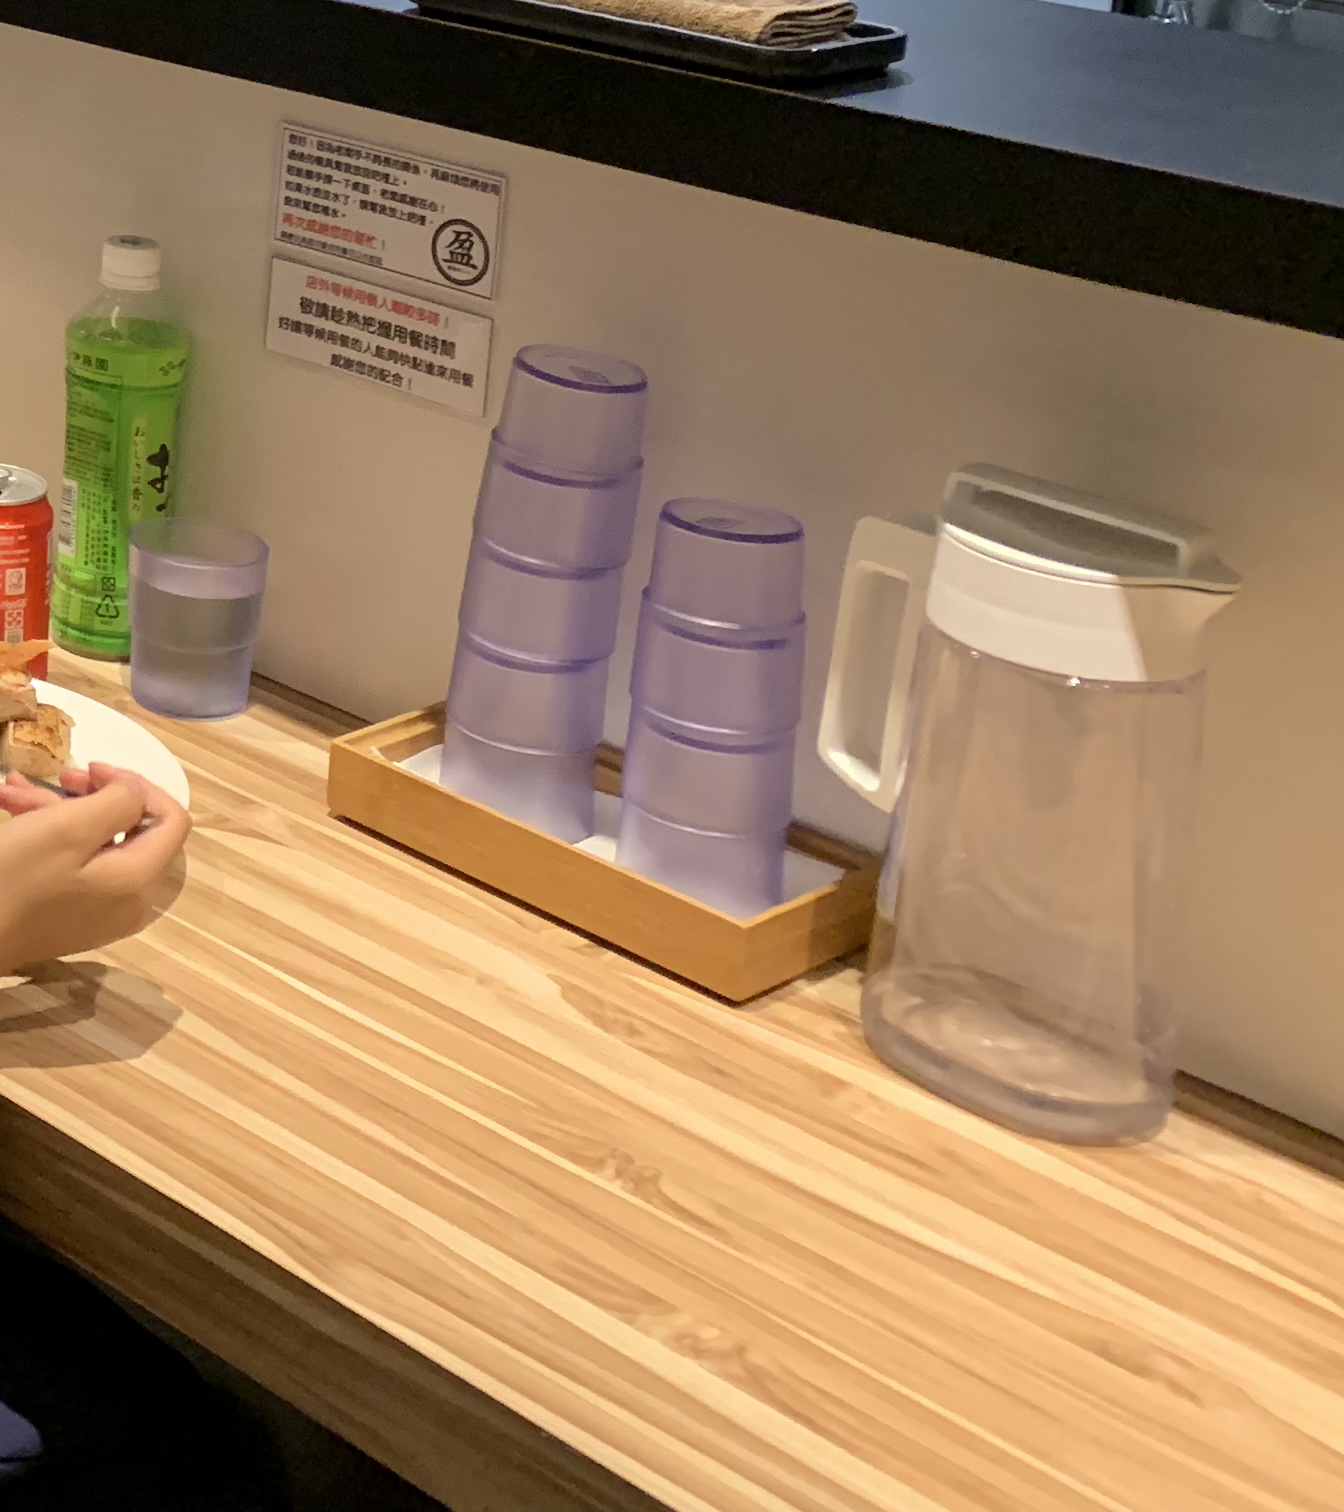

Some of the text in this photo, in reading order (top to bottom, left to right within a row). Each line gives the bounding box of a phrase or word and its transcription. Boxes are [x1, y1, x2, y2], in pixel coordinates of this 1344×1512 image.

[441, 229, 478, 270] 盈
[299, 296, 456, 360] 敬請趁熱把握用餐時間
[330, 352, 413, 391] 感謝您的配合！
